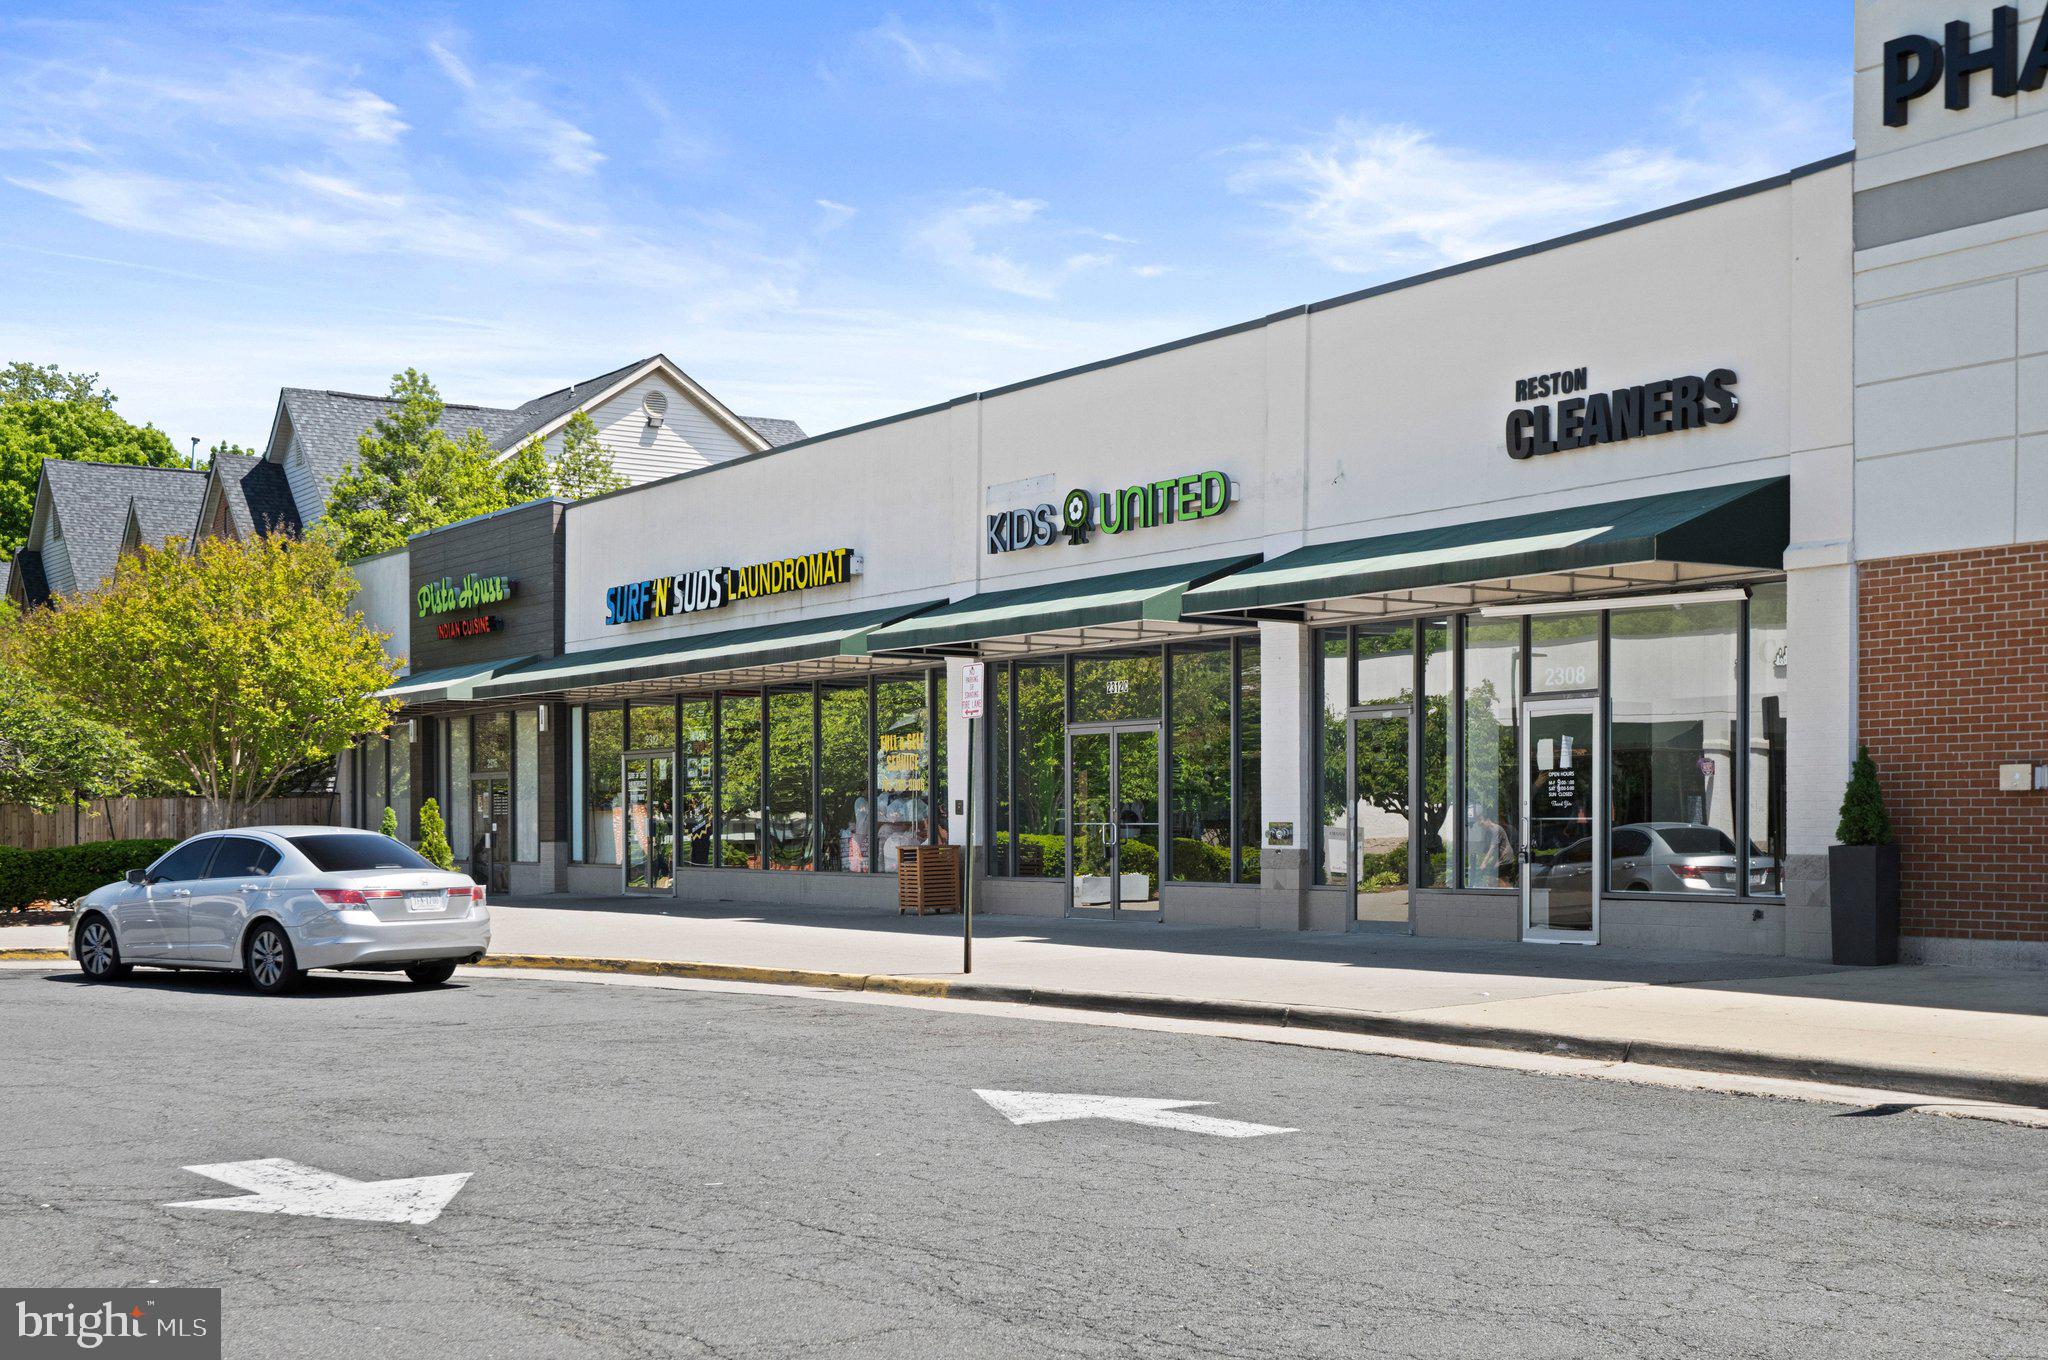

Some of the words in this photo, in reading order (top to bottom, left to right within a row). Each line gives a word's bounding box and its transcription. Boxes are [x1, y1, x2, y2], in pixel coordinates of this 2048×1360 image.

[1515, 367, 1587, 402] RESTON
[1506, 368, 1739, 460] CLEANERS
[987, 503, 1057, 555] KIDS
[1100, 470, 1232, 535] UNITED
[417, 577, 459, 618] Pista
[459, 574, 507, 609] House
[605, 580, 650, 625] SURF
[672, 567, 724, 614] SUDS
[727, 548, 848, 600] LAUNDROMAT
[436, 620, 461, 640] INDIAN
[462, 615, 491, 636] CUISINE
[1544, 666, 1585, 686] 2308
